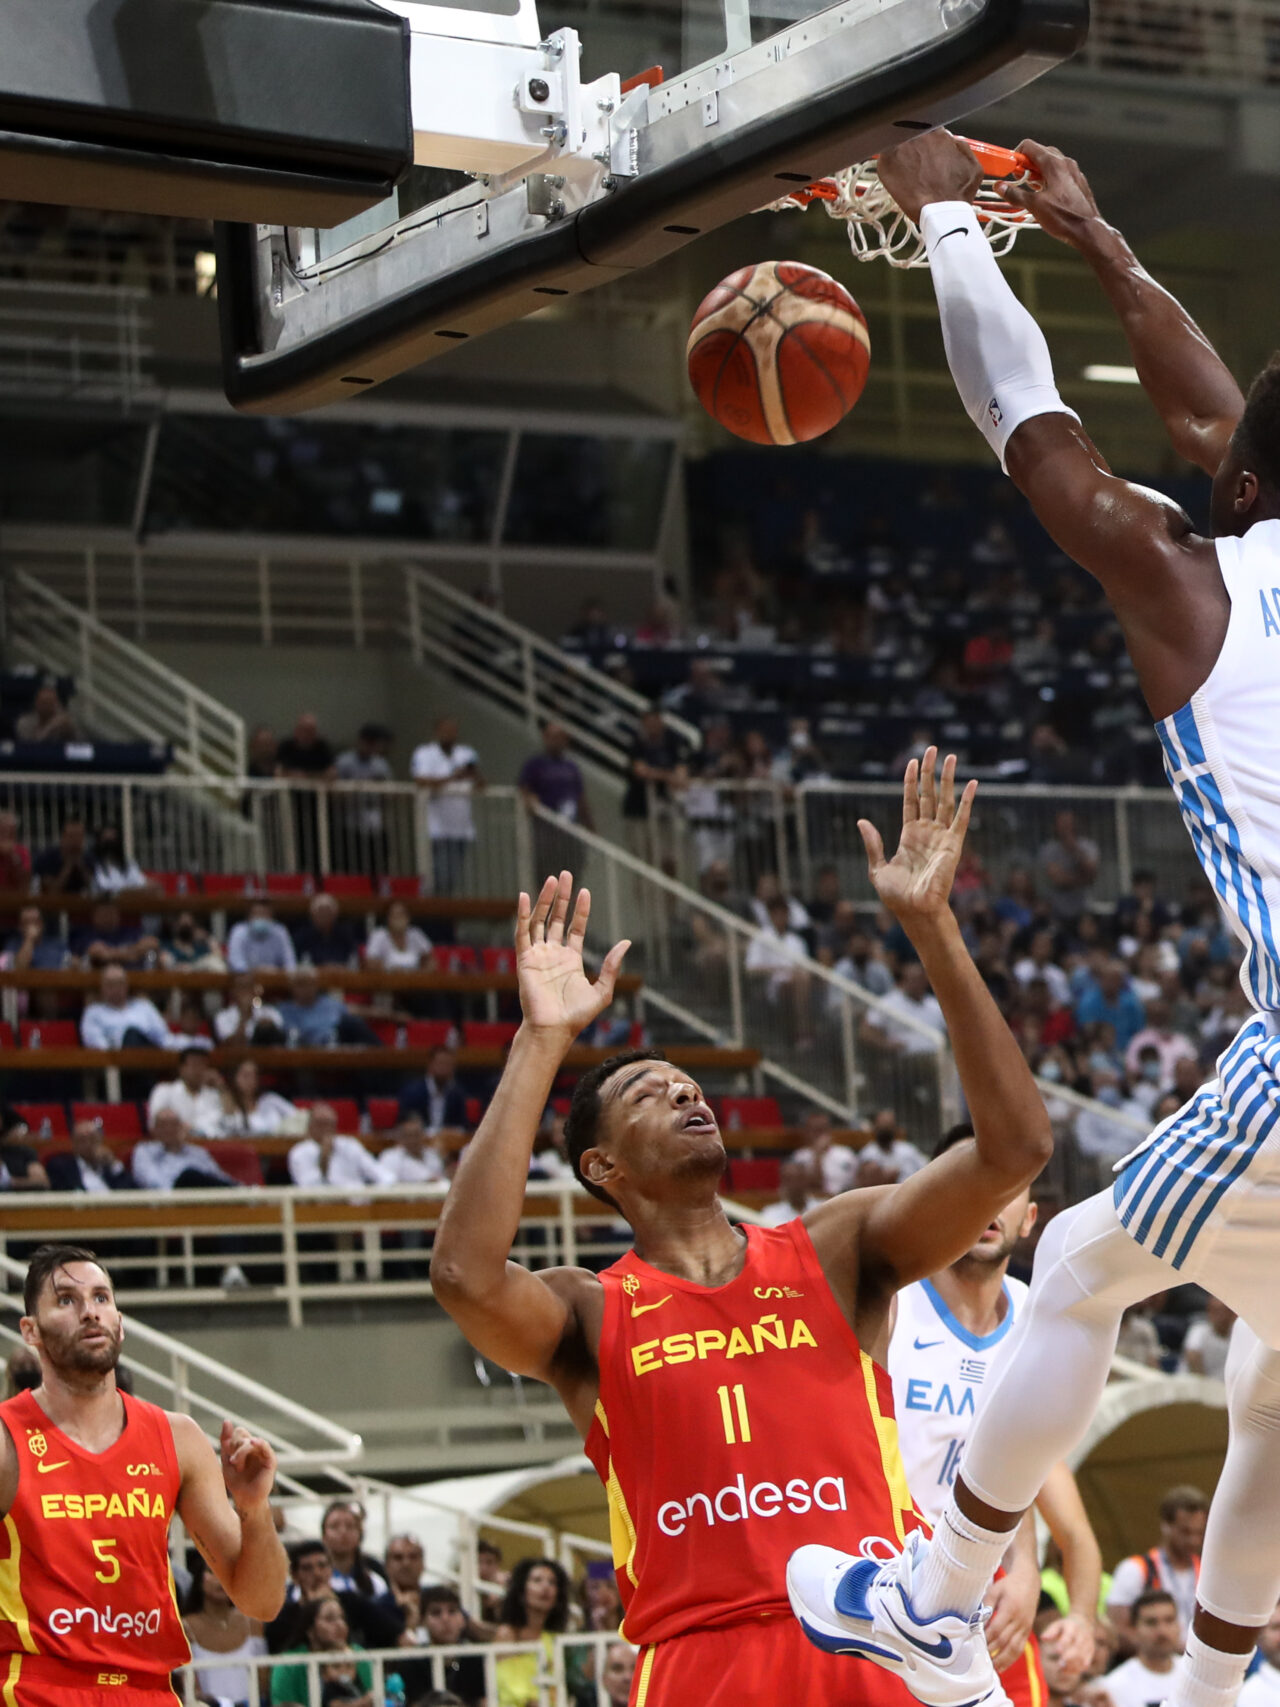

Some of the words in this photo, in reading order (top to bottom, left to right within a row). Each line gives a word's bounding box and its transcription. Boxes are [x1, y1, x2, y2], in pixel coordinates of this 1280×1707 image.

[630, 1313, 818, 1377] ESPAÑA
[716, 1383, 752, 1444] 11
[904, 1378, 976, 1417] ΕΛΛ
[40, 1487, 166, 1520] ESPAÑA
[656, 1473, 848, 1537] endesa
[91, 1538, 121, 1584] 5
[48, 1605, 161, 1638] endesa
[96, 1672, 128, 1686] ESP
